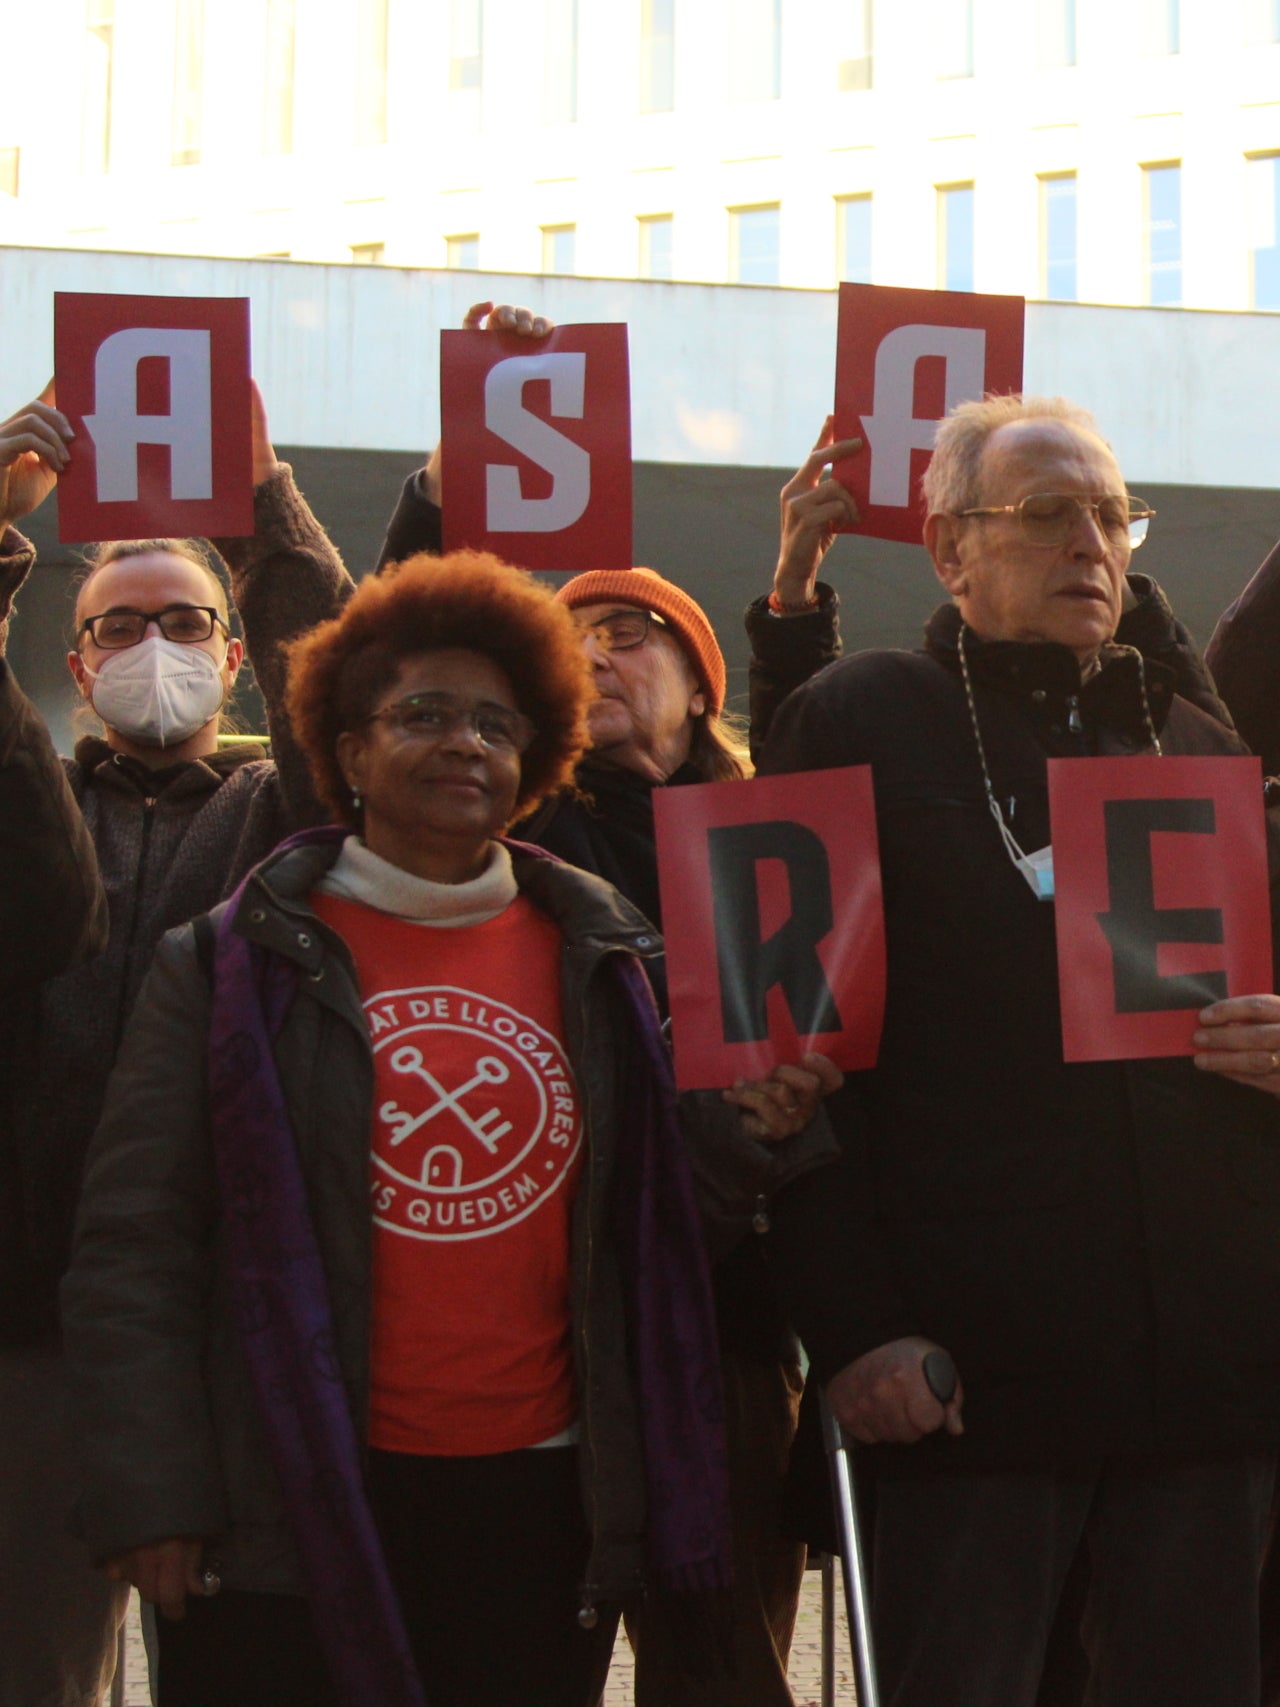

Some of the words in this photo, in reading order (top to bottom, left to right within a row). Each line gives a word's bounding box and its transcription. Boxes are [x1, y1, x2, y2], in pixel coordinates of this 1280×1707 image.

[82, 327, 212, 502] A
[484, 352, 590, 532] S
[706, 820, 843, 1043] R
[1095, 798, 1229, 1014] E
[369, 1005, 400, 1037] AT
[409, 998, 450, 1019] DE
[460, 1002, 575, 1148] LLOGATERES
[371, 1180, 397, 1210] S
[407, 1172, 540, 1226] QUEDEM
